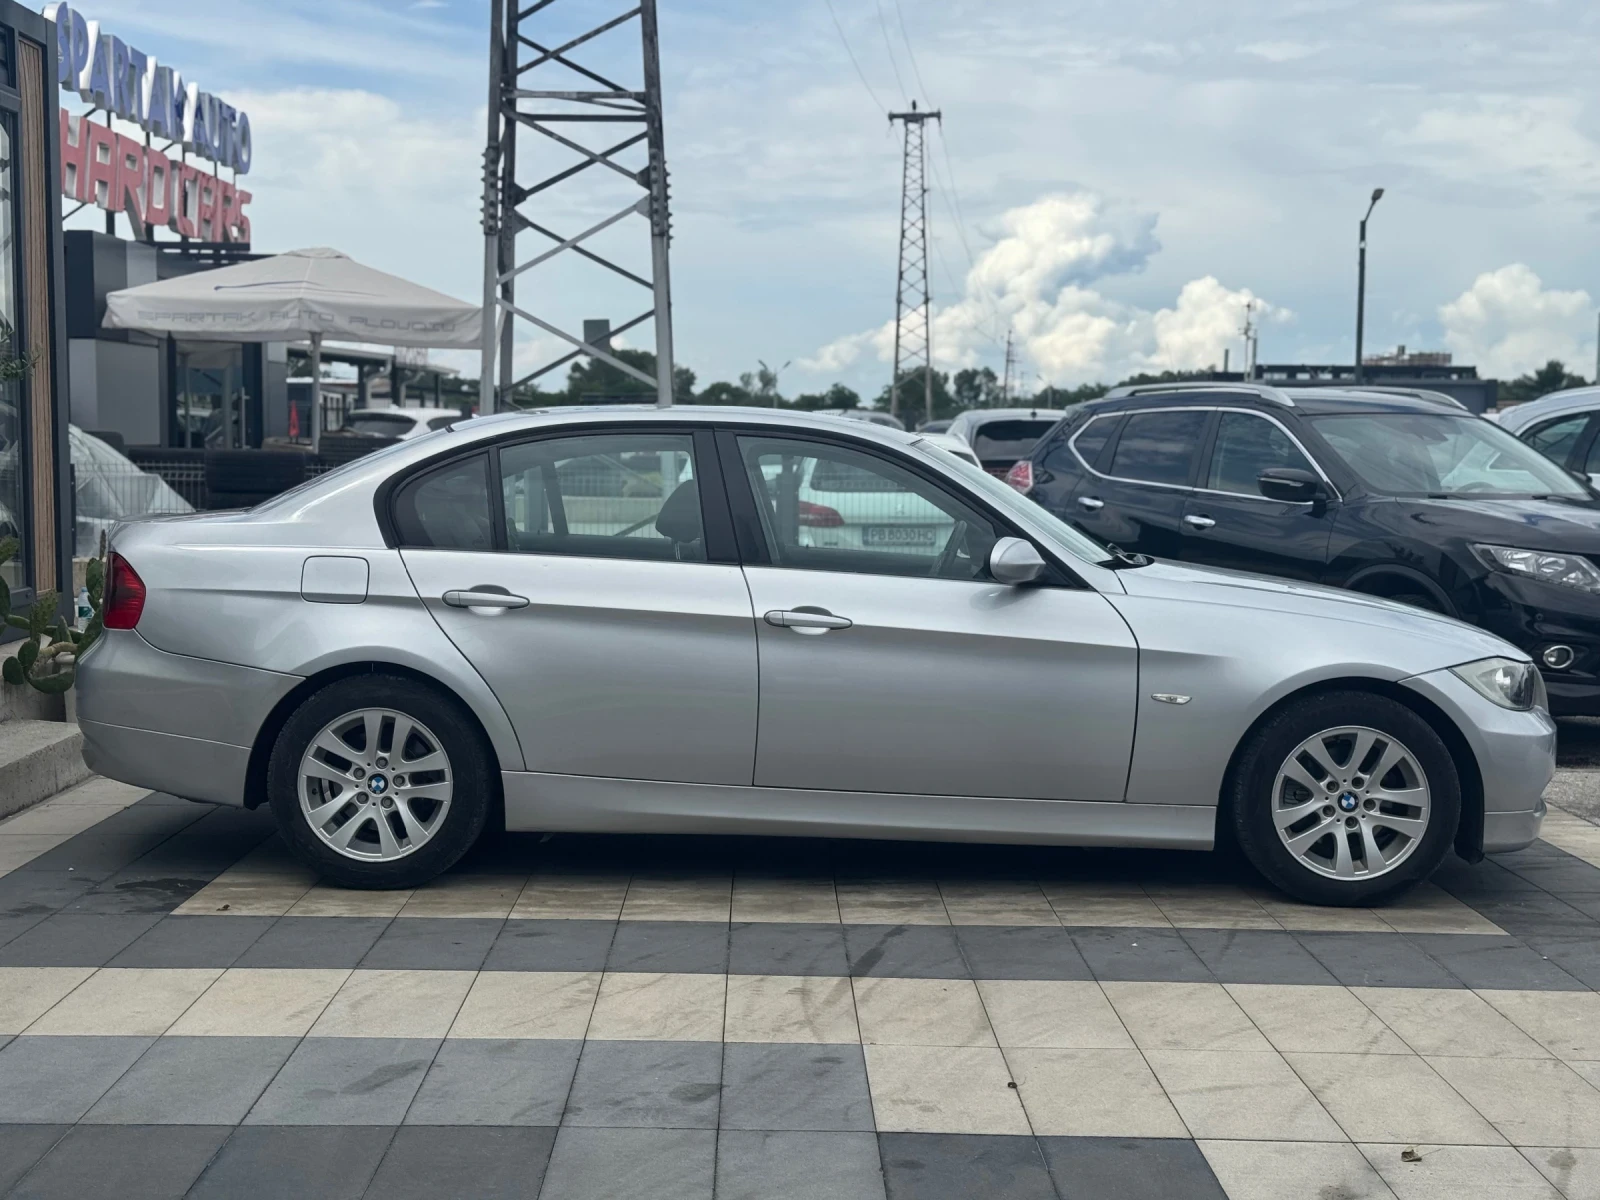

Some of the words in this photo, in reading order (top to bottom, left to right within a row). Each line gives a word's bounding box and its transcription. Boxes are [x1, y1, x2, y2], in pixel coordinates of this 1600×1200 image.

[48, 2, 186, 144] SPARTAK
[183, 82, 252, 174] AUTO
[138, 310, 256, 323] SPARTAK
[269, 310, 335, 323] AUTO
